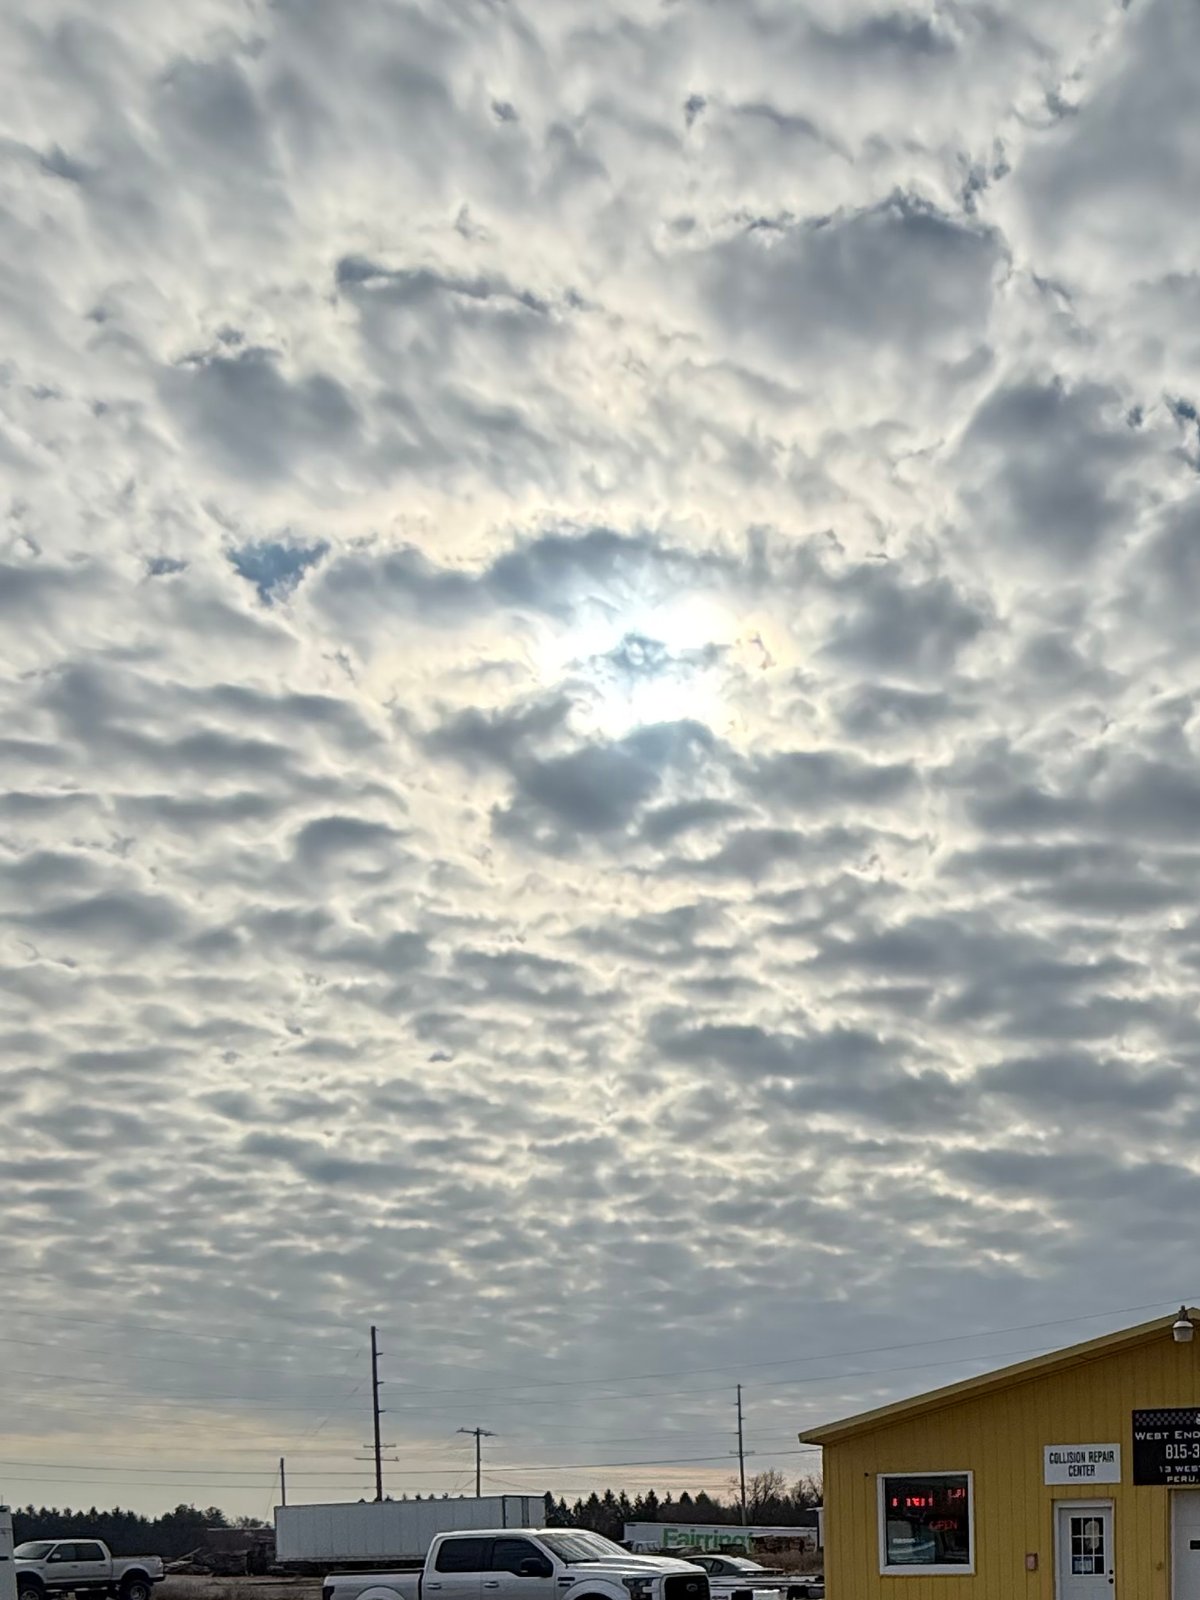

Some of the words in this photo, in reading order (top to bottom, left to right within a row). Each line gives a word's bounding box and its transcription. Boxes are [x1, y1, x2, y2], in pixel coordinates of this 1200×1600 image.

[1049, 1451, 1085, 1464] COLLISION
[1088, 1450, 1115, 1463] REPAIR
[1068, 1464, 1096, 1477] CENTER
